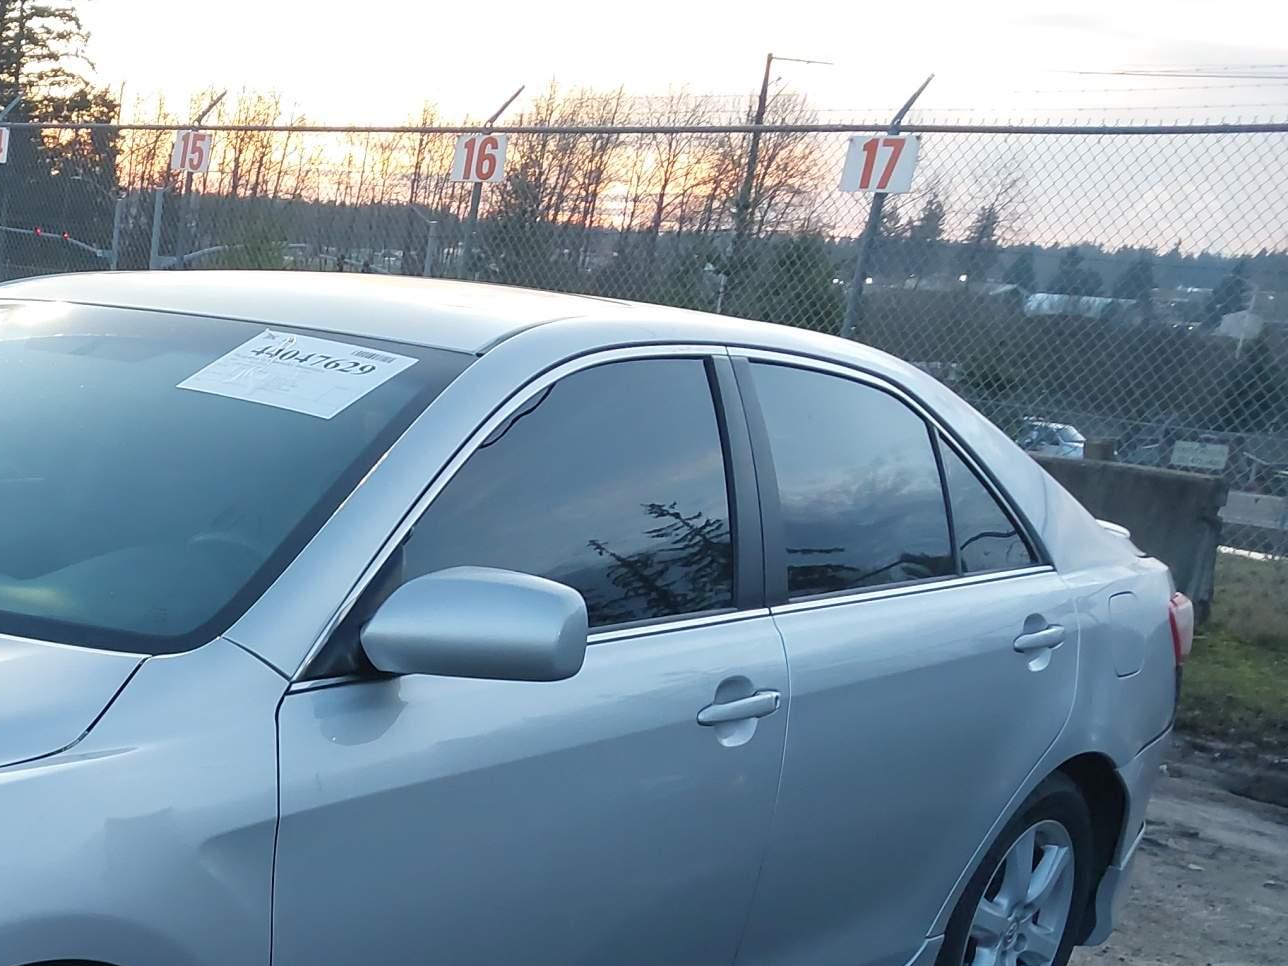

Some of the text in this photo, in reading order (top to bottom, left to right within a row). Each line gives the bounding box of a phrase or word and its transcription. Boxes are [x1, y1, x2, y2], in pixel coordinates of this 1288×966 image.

[179, 132, 207, 171] 15
[462, 136, 499, 180] 16
[859, 138, 906, 189] 17
[251, 345, 376, 375] 44047629
